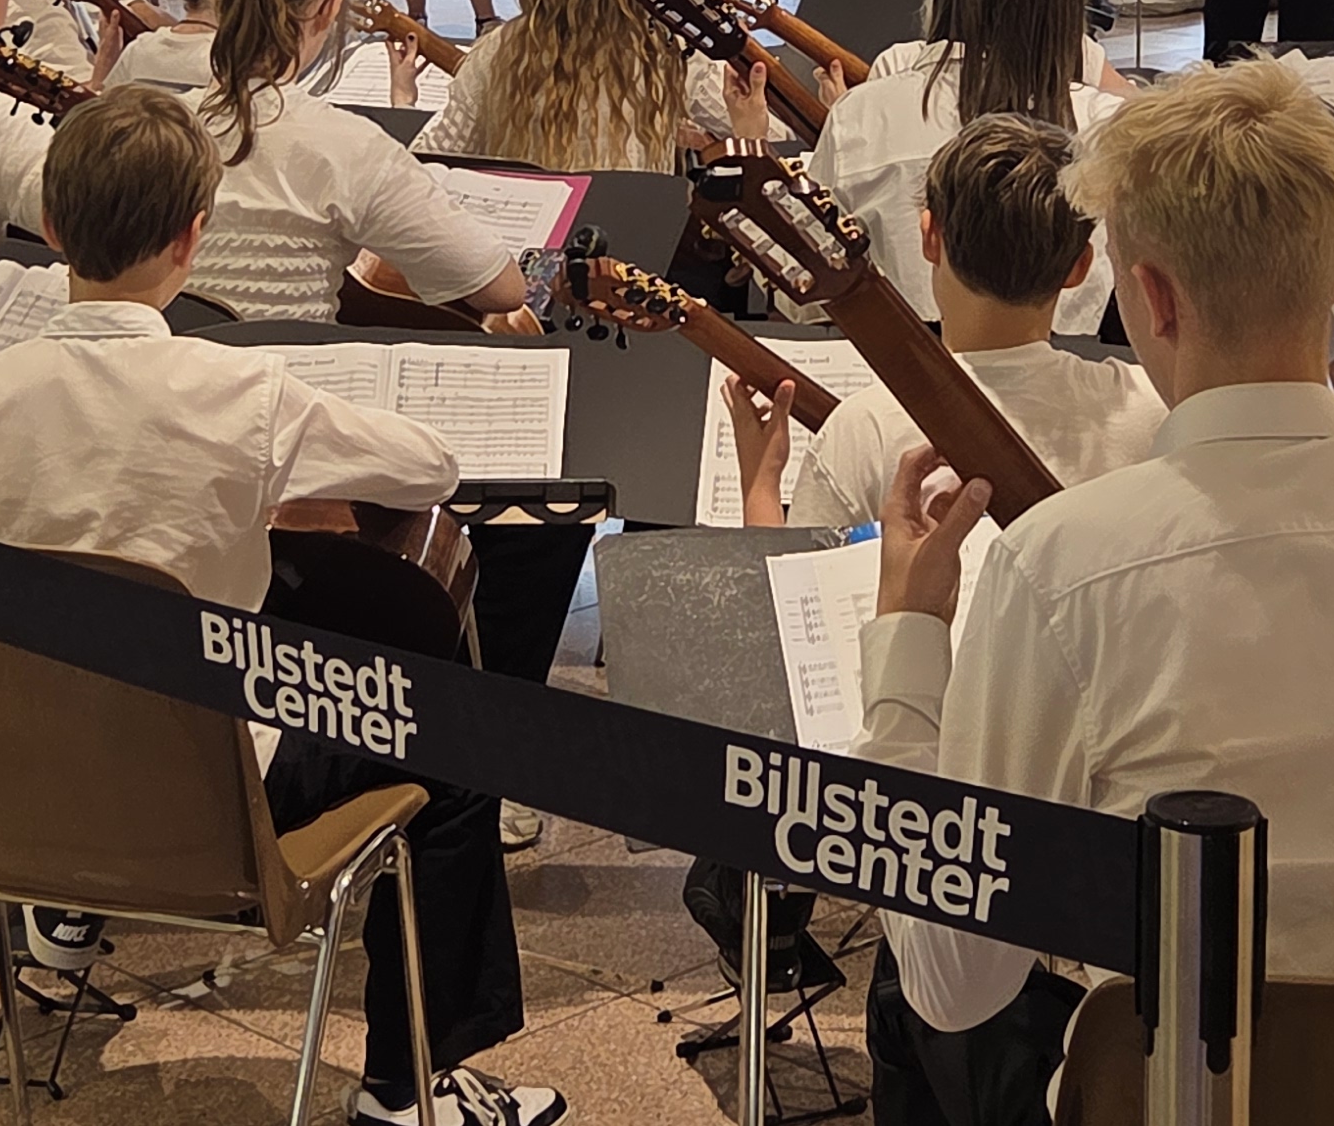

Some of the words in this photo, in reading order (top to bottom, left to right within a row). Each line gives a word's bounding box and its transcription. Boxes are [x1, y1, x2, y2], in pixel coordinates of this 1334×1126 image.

[201, 611, 413, 720] Billstedt
[242, 664, 418, 761] Center
[724, 745, 1011, 873] Billstedt
[774, 807, 1011, 924] Center
